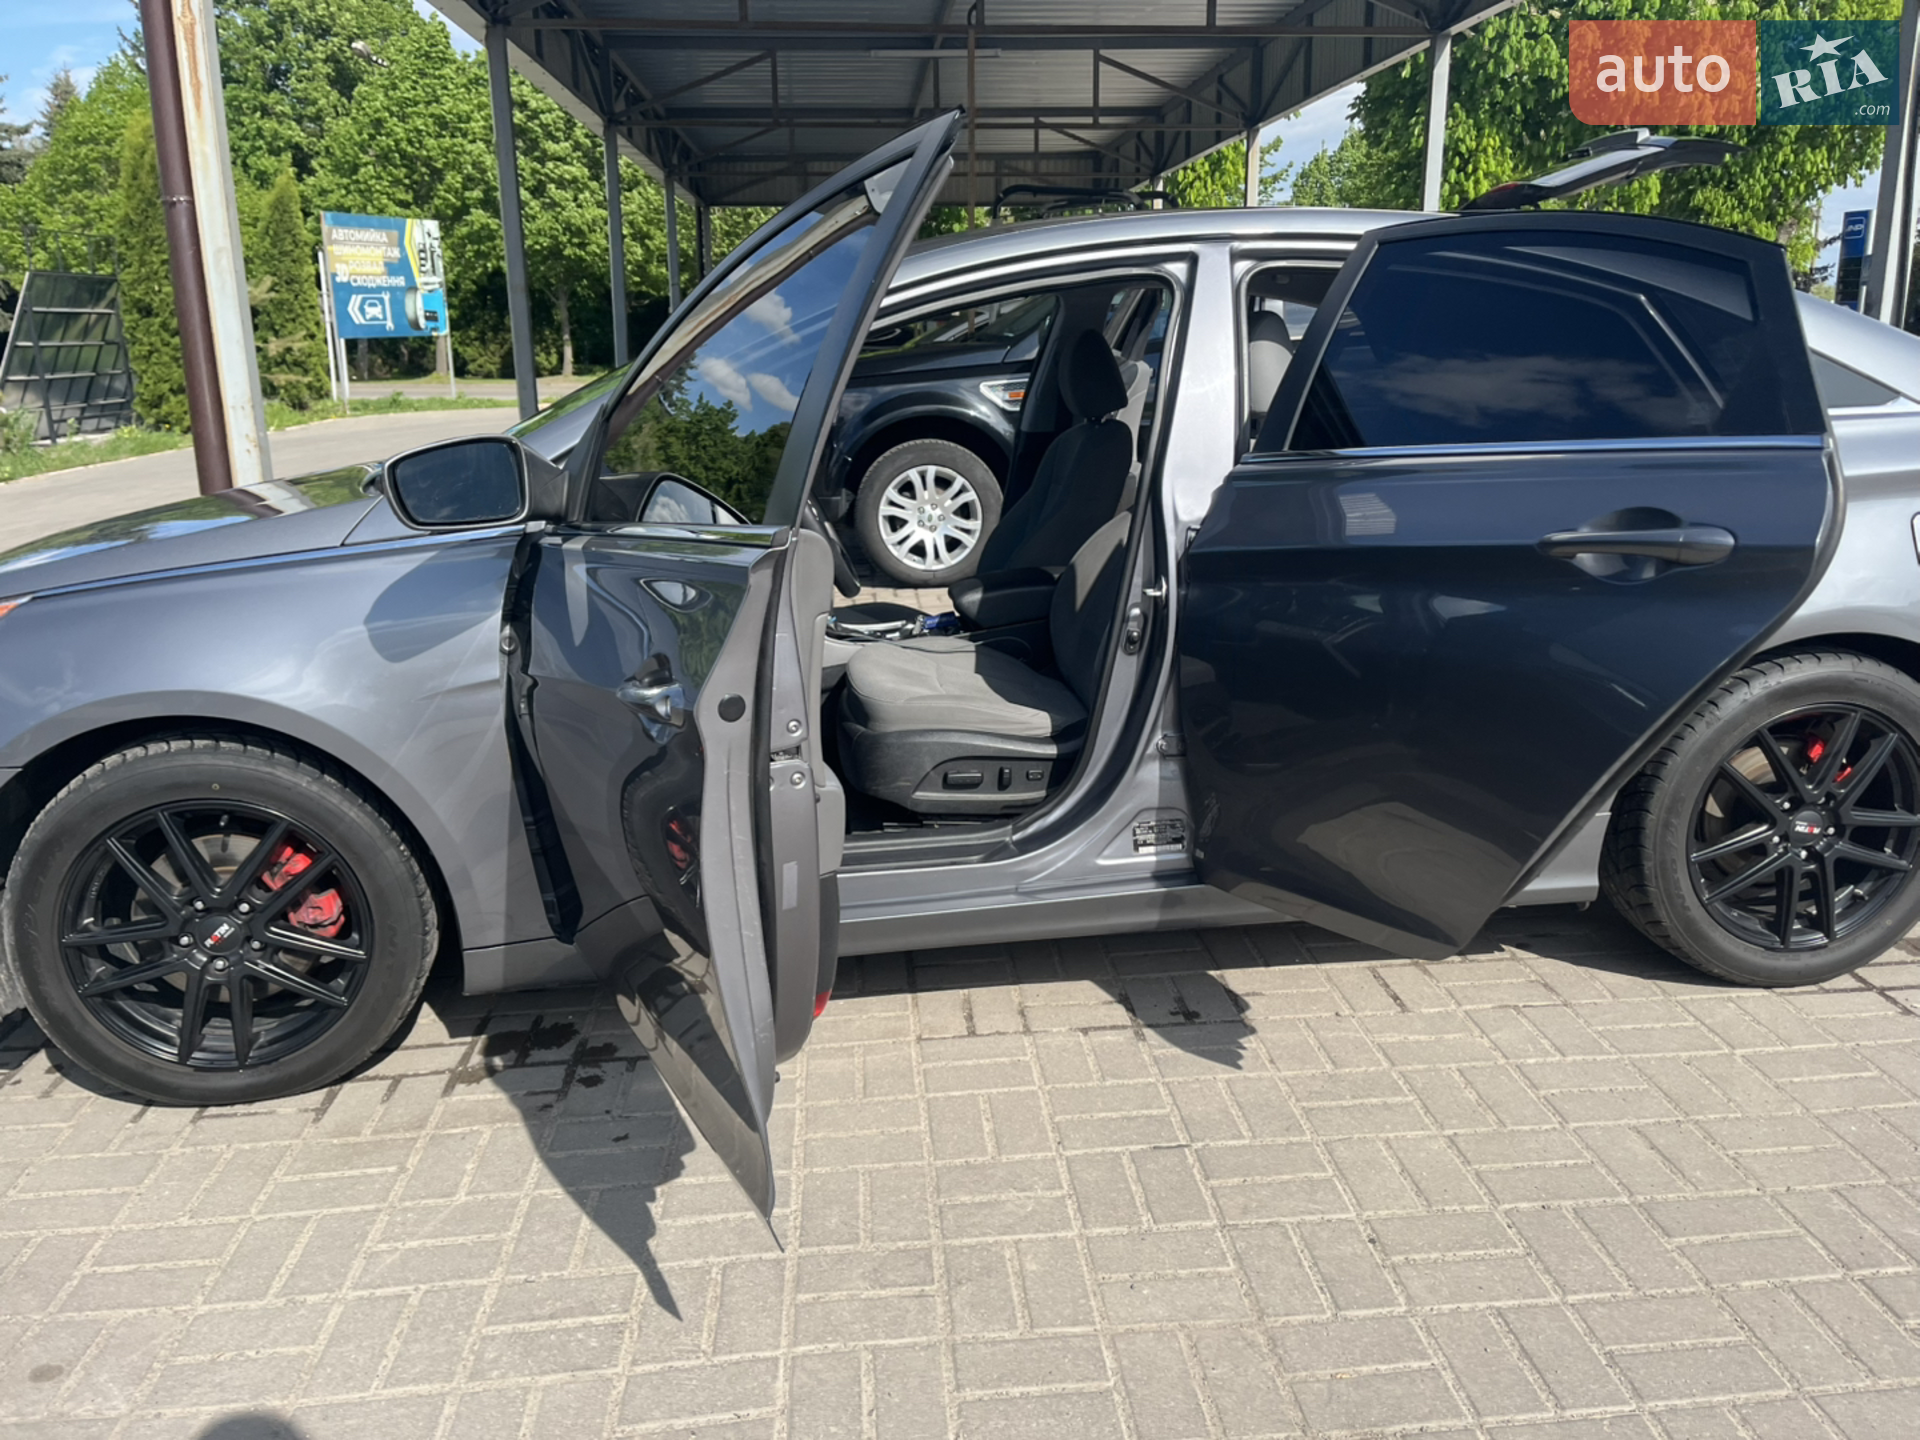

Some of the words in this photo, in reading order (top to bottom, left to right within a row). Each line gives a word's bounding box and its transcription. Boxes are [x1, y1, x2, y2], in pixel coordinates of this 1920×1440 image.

[332, 229, 388, 243] АВТОМИЙКА
[333, 244, 400, 258] ШИНОМОНТАЖ
[351, 275, 405, 288] СХОДЖЕННЯ
